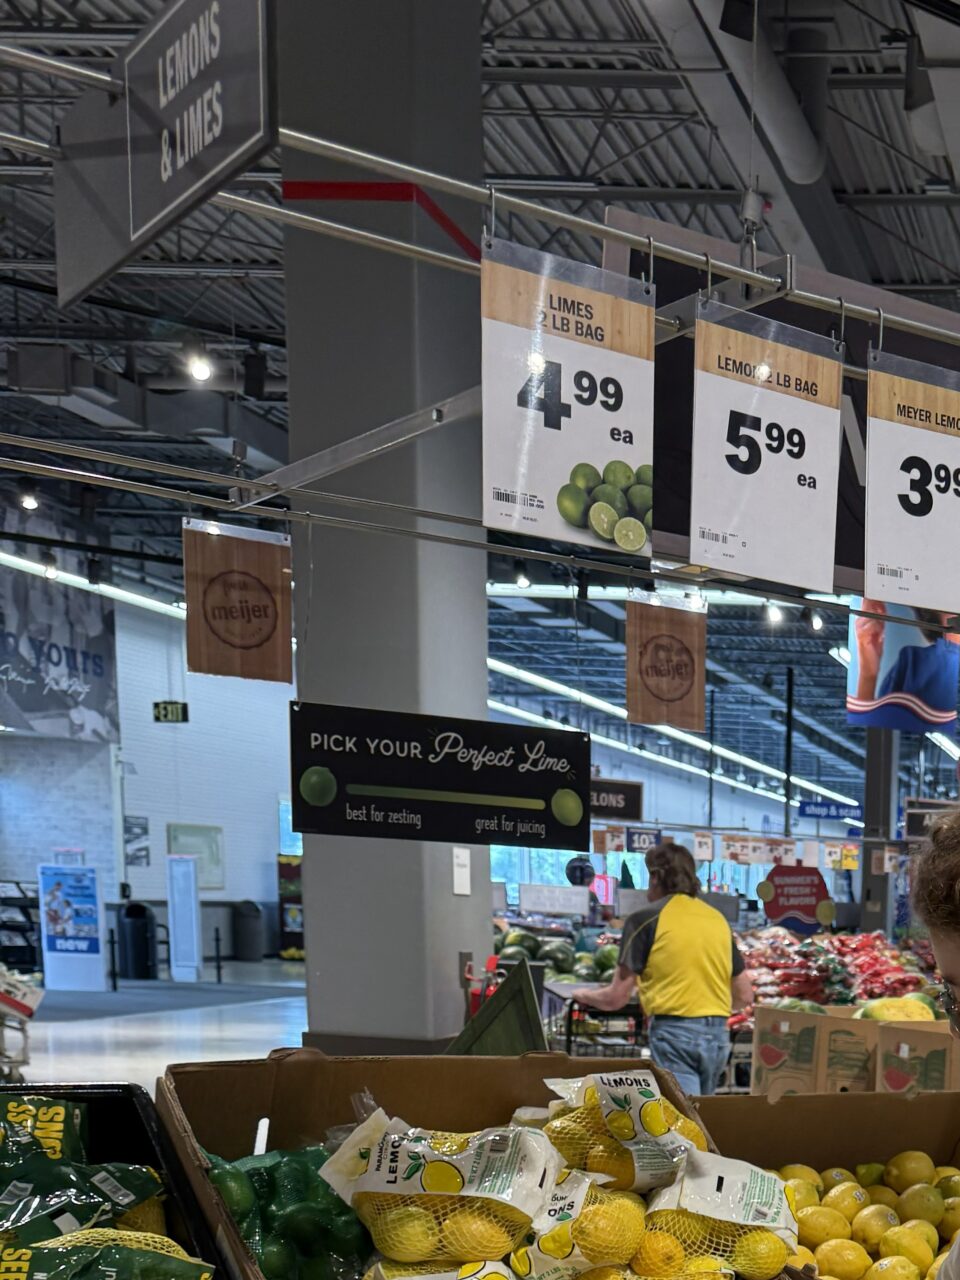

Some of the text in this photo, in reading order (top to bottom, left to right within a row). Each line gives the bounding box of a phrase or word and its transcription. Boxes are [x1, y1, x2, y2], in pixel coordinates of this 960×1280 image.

[159, 1, 221, 109] LEMONS
[161, 81, 223, 182] & LIMES
[550, 294, 594, 321] LIMES
[552, 313, 571, 333] LB
[574, 319, 605, 342] BAG
[717, 355, 765, 382] LEMO
[776, 372, 791, 388] LB
[794, 377, 818, 396] BAG
[896, 403, 931, 423] MEYER
[610, 427, 634, 445] ea
[797, 473, 817, 489] ea
[212, 602, 271, 624] meijer
[27, 635, 104, 677] yours
[159, 703, 183, 722] EXIT
[310, 731, 571, 773] PICK YOUR Perfect Lime
[591, 792, 625, 808] LONS
[346, 803, 422, 829] best for zesting
[805, 806, 828, 817] shop
[830, 806, 837, 814] &
[475, 815, 545, 837] great for juicing
[600, 1076, 651, 1088] LEMONS
[386, 1141, 401, 1184] LEMO
[548, 1201, 574, 1217] ONS
